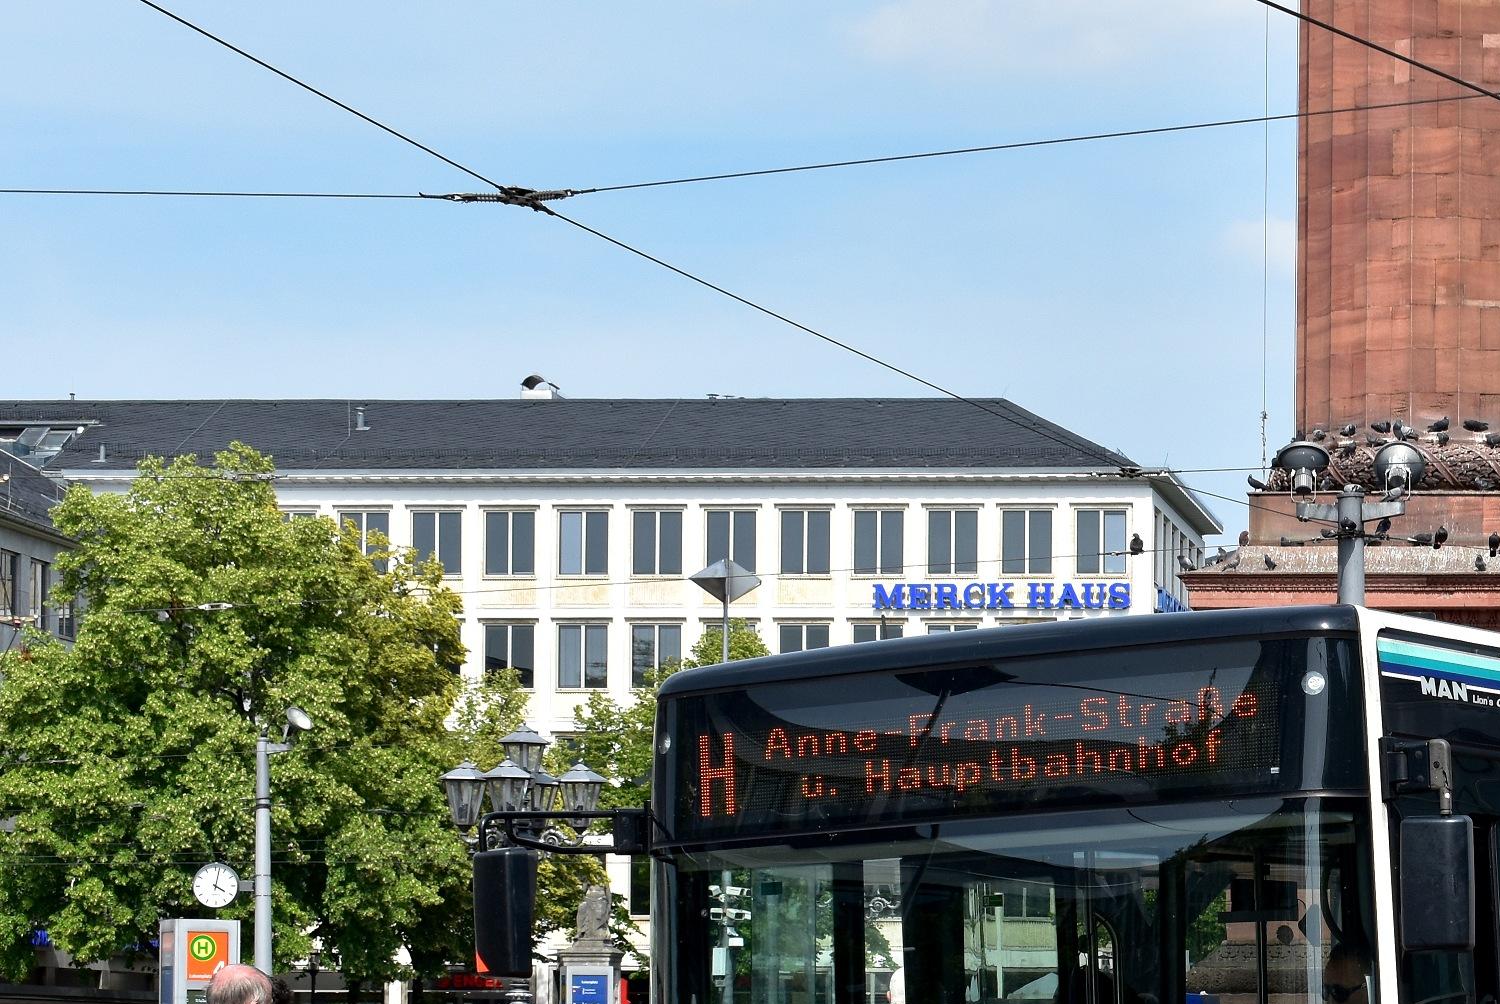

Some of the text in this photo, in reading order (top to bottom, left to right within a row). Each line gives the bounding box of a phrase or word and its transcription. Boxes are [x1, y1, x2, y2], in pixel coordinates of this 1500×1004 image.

[872, 582, 1015, 609] MERCK
[1028, 582, 1132, 609] HAUS
[765, 686, 1258, 760] Anne-Frank-Straße
[1420, 676, 1468, 702] MAN
[1472, 694, 1494, 706] Lion's
[699, 732, 736, 817] H
[801, 729, 1223, 798] u. Hauptbahnhof
